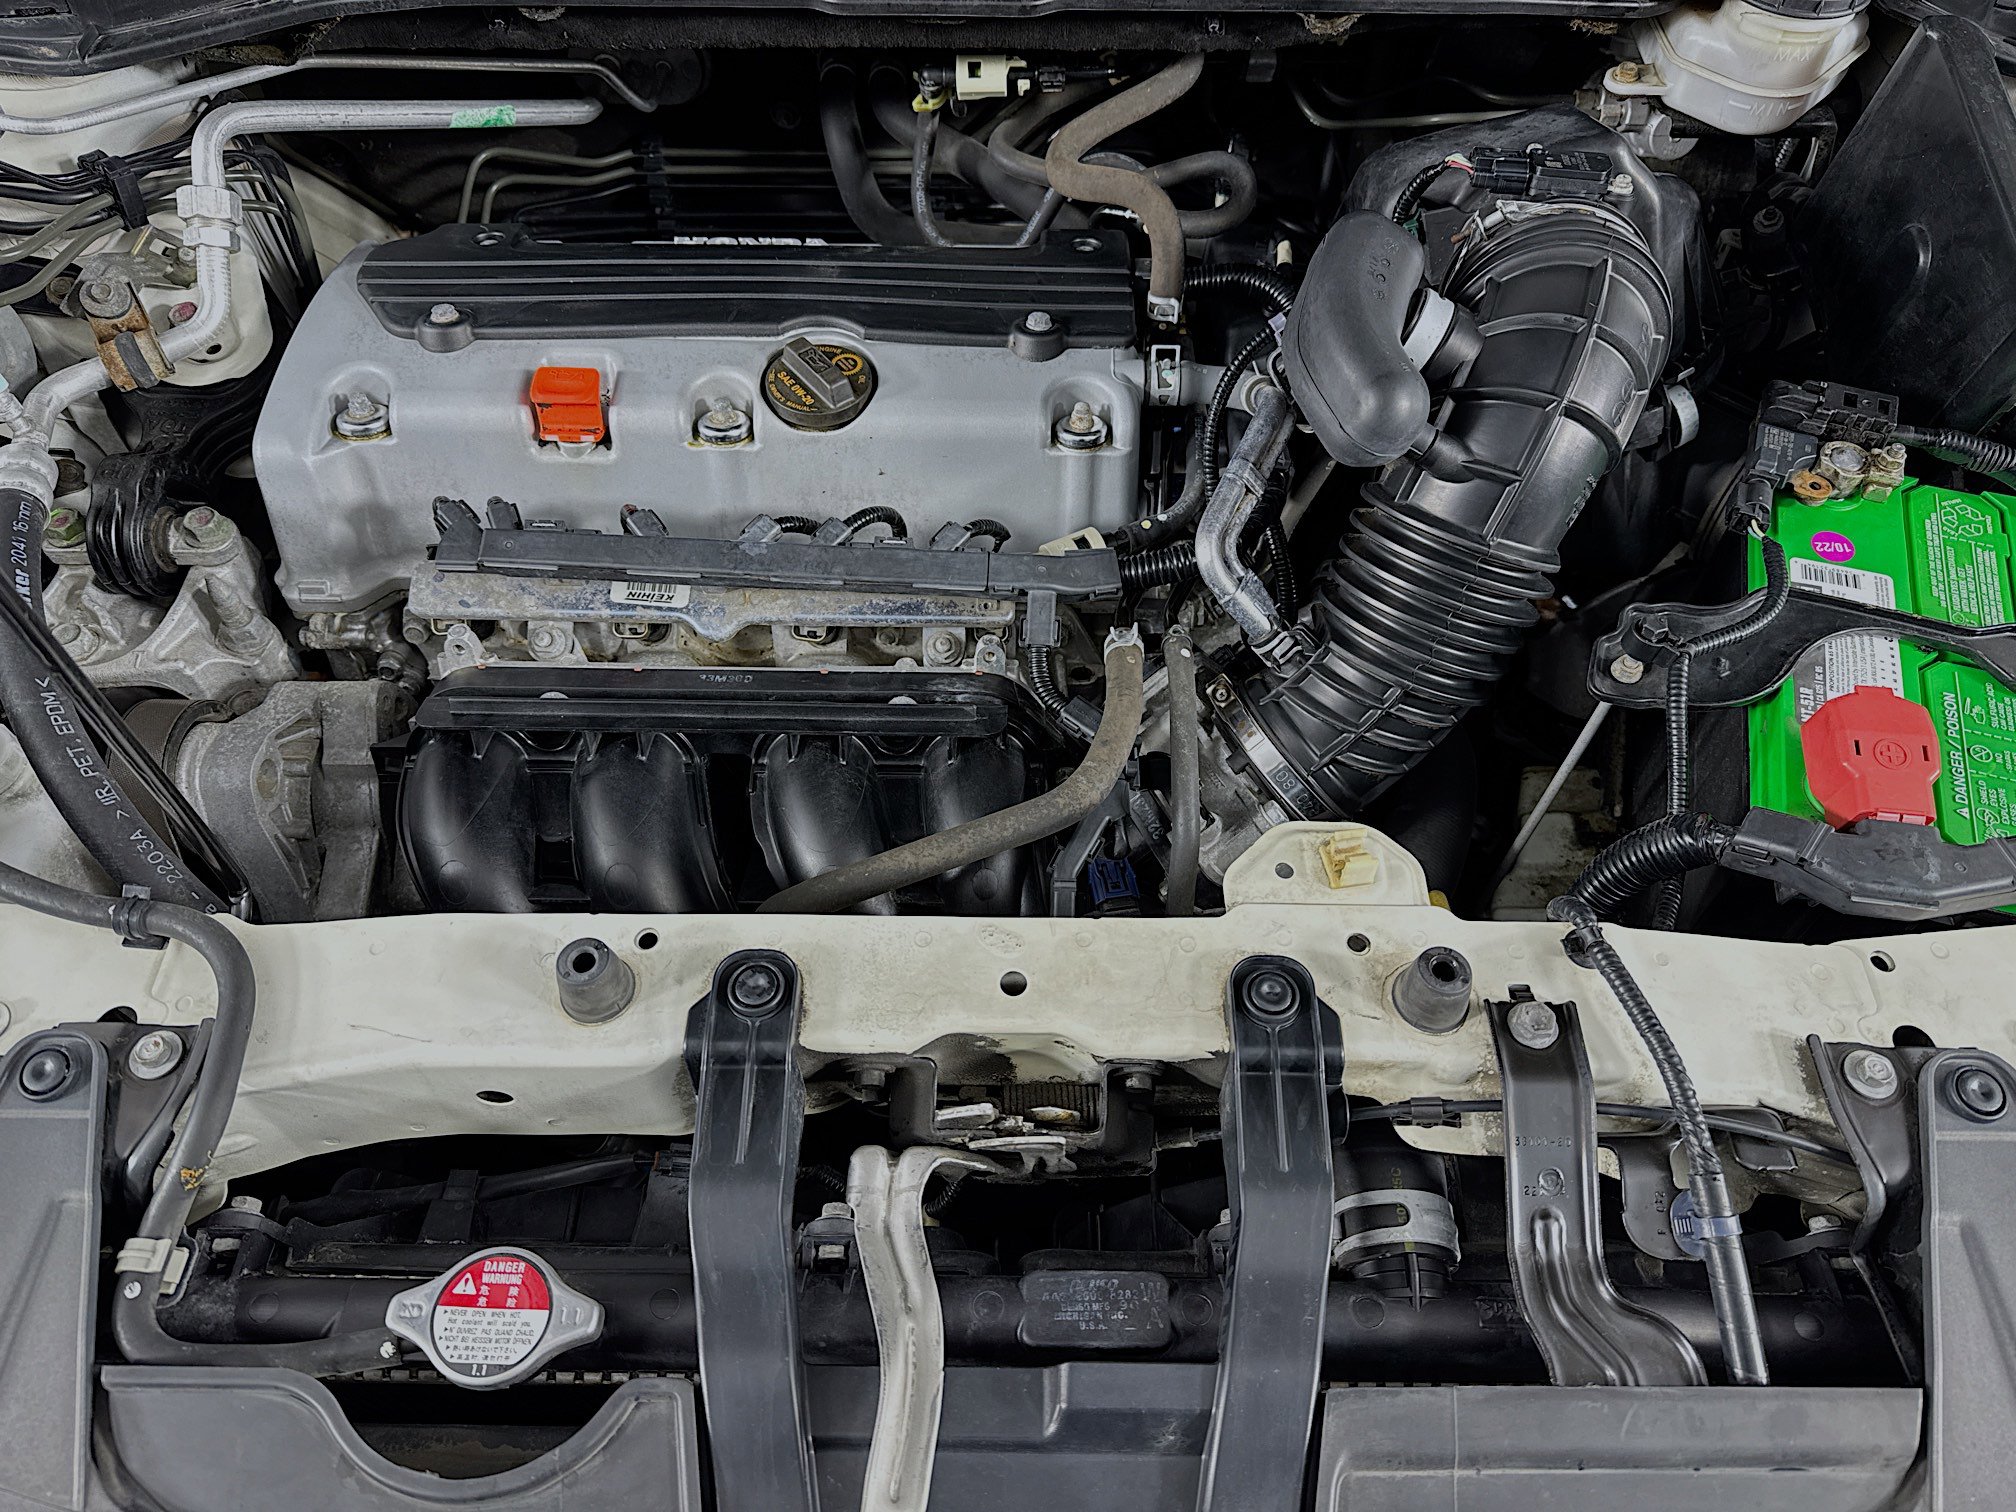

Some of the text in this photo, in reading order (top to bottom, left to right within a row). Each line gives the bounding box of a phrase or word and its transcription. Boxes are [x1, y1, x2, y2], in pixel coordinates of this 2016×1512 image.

[1774, 46, 1815, 61] MAX
[1750, 102, 1789, 117] MIN
[777, 371, 815, 406] SAE 0W-20
[786, 400, 812, 412] MANUAL
[1814, 541, 1852, 553] 10/22
[626, 591, 675, 603] KEIHIN
[1986, 682, 2000, 729] SULFURIC ACID
[1942, 692, 1961, 738] POISON
[1994, 753, 2004, 763] NO
[1950, 751, 1969, 805] DANGER
[1978, 780, 1989, 805] SHIELD
[1988, 788, 1998, 807] EYES
[1998, 788, 2010, 825] EXPLOSIVE
[130, 828, 184, 884] 2203A
[484, 1260, 525, 1273] DANGER
[482, 1272, 524, 1285] WARNUNG
[450, 1309, 468, 1317] NEVER
[472, 1310, 486, 1318] OPEN
[457, 1327, 478, 1335] OUVREZ
[471, 1364, 488, 1376] 1.1
